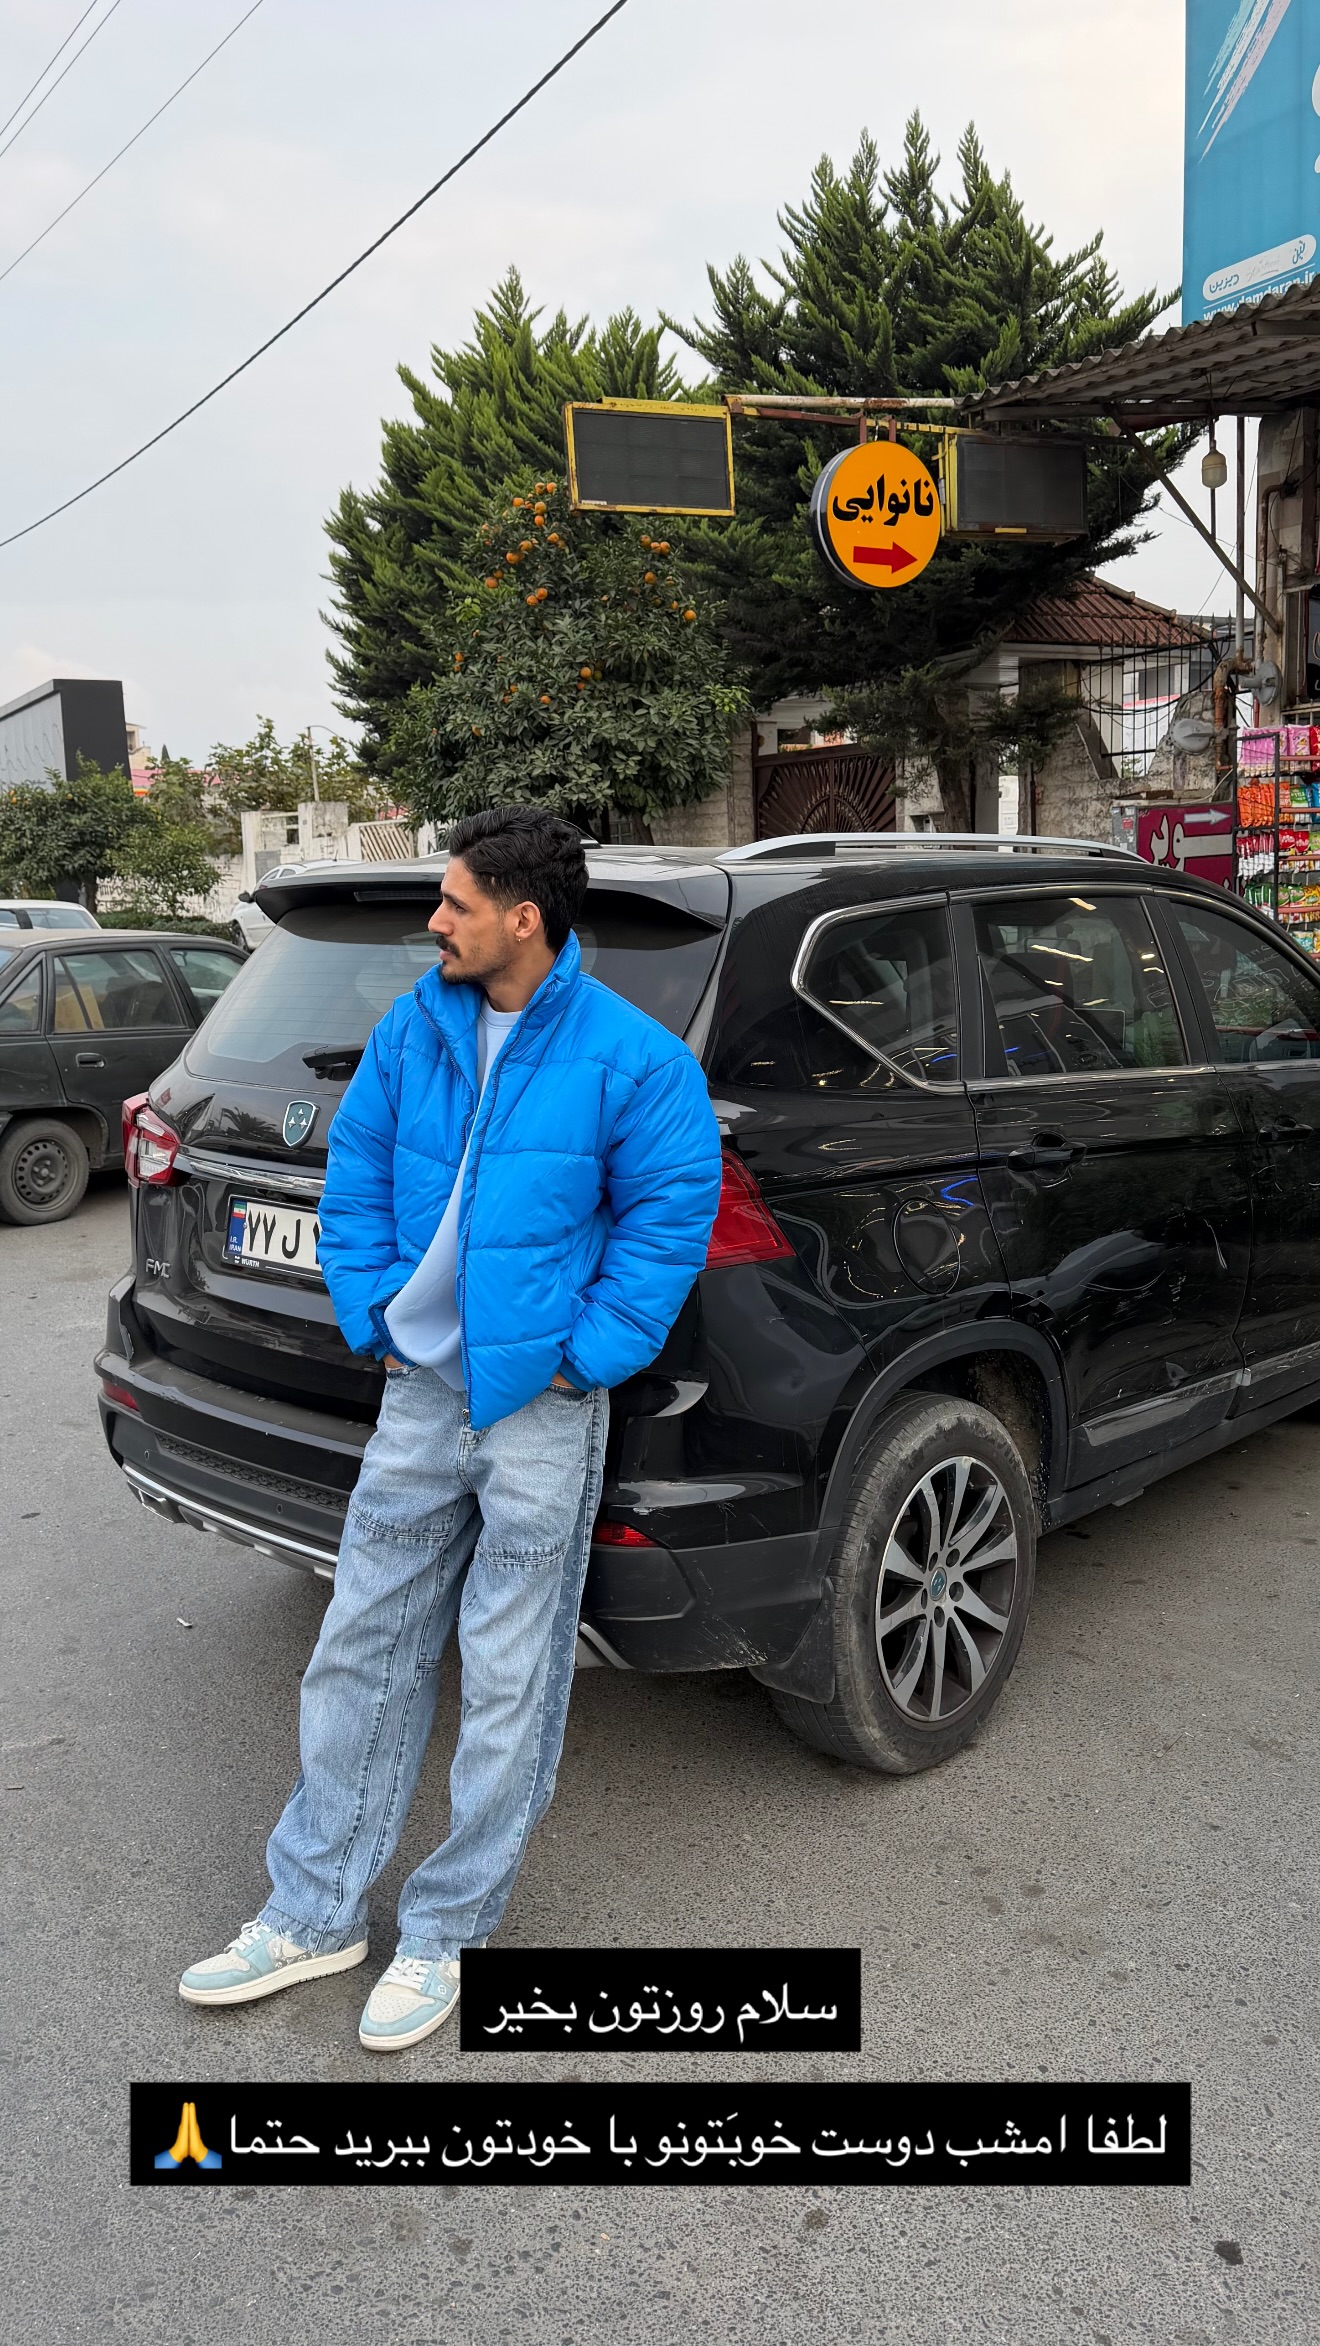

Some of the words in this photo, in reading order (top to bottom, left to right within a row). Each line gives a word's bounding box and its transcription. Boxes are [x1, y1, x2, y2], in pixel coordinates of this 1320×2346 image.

[832, 473, 935, 526] نانوایی
[228, 1243, 242, 1252] IRAN
[145, 1258, 171, 1278] FMC
